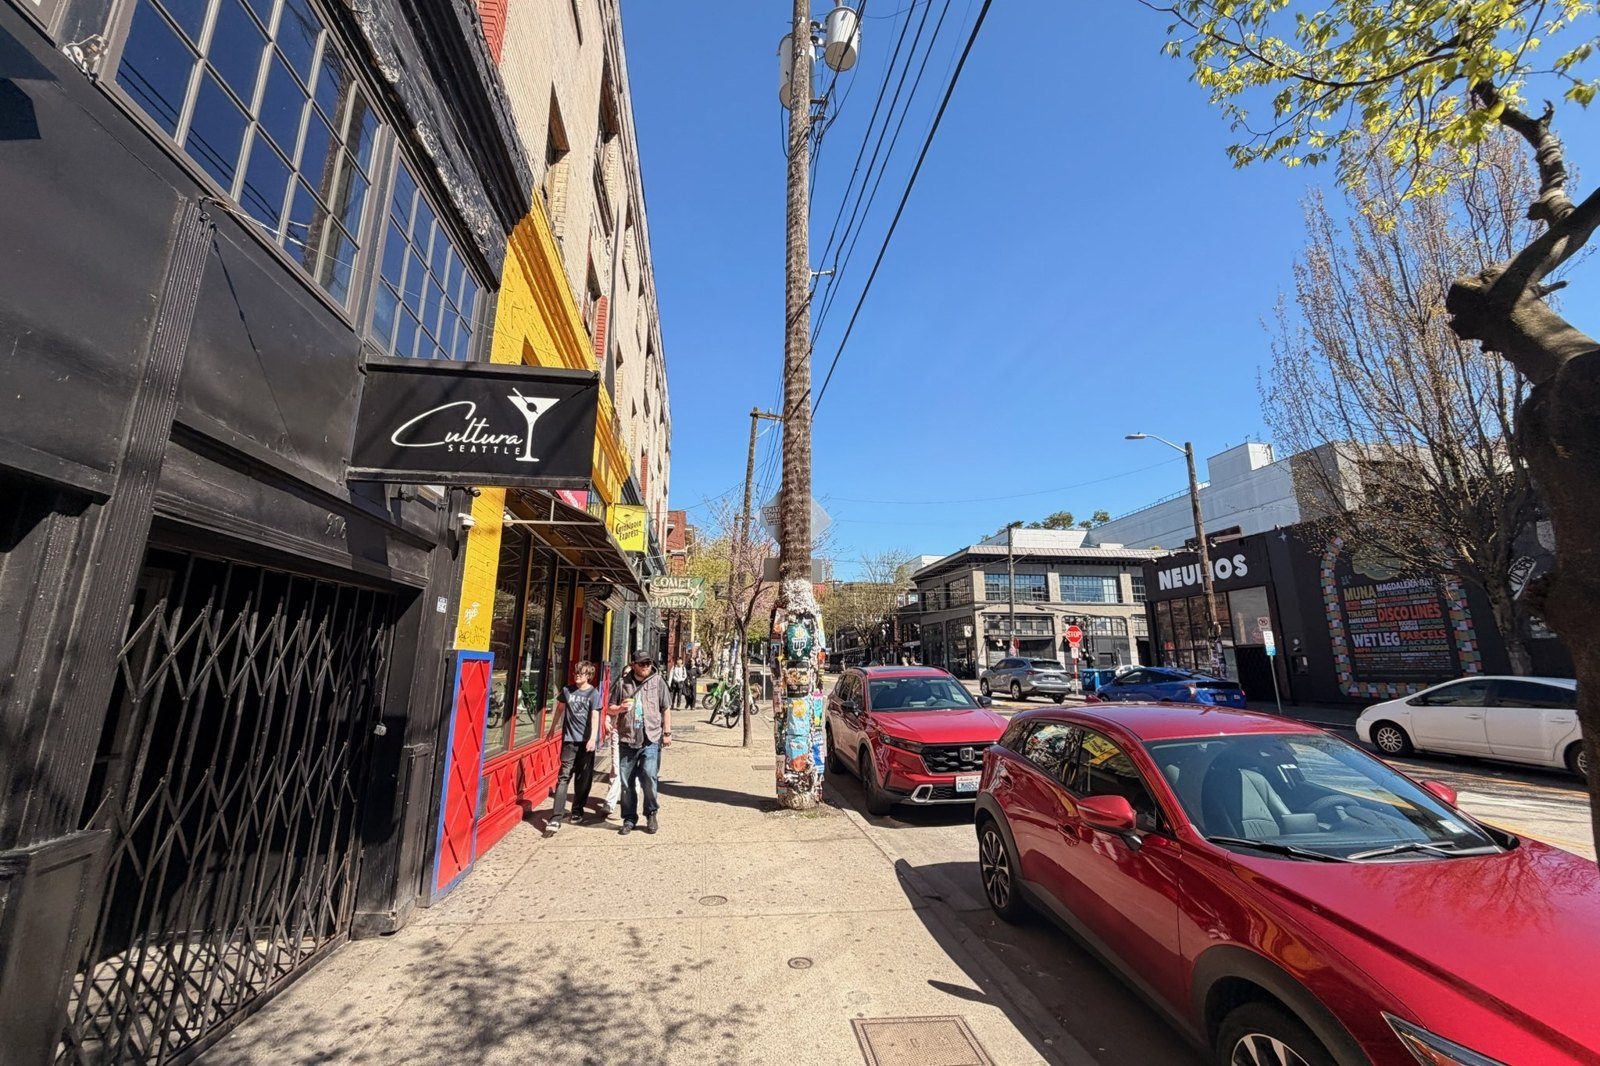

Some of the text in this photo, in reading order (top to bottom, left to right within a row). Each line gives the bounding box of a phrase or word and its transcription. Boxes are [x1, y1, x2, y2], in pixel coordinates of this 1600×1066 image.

[391, 401, 523, 447] Cultura
[448, 444, 521, 455] SEATTLE
[653, 577, 692, 588] COMET
[1344, 586, 1377, 600] MUNA
[1377, 605, 1409, 621] DISCO
[1410, 603, 1442, 619] LINES
[1352, 631, 1401, 647] WET LEG
[1400, 630, 1447, 640] PARCELS
[794, 641, 805, 650] UP
